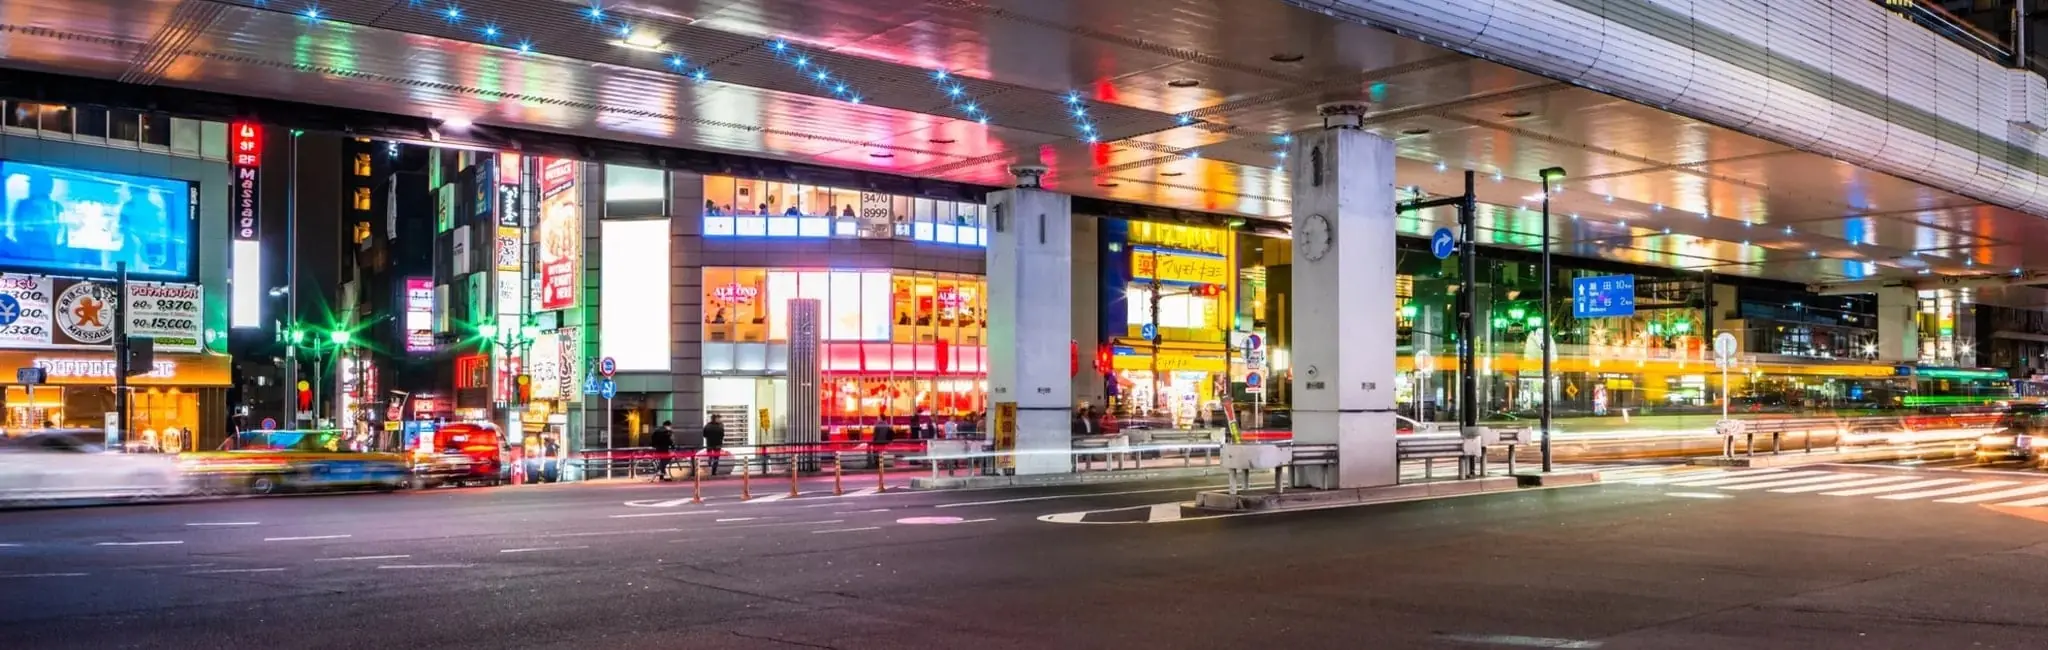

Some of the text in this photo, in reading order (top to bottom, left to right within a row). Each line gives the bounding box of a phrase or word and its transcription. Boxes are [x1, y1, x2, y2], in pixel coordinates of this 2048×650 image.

[238, 154, 256, 165] 2F
[240, 168, 256, 238] Massage
[864, 193, 888, 203] 3470
[864, 208, 888, 218] 8999
[67, 325, 113, 339] MASSAGE
